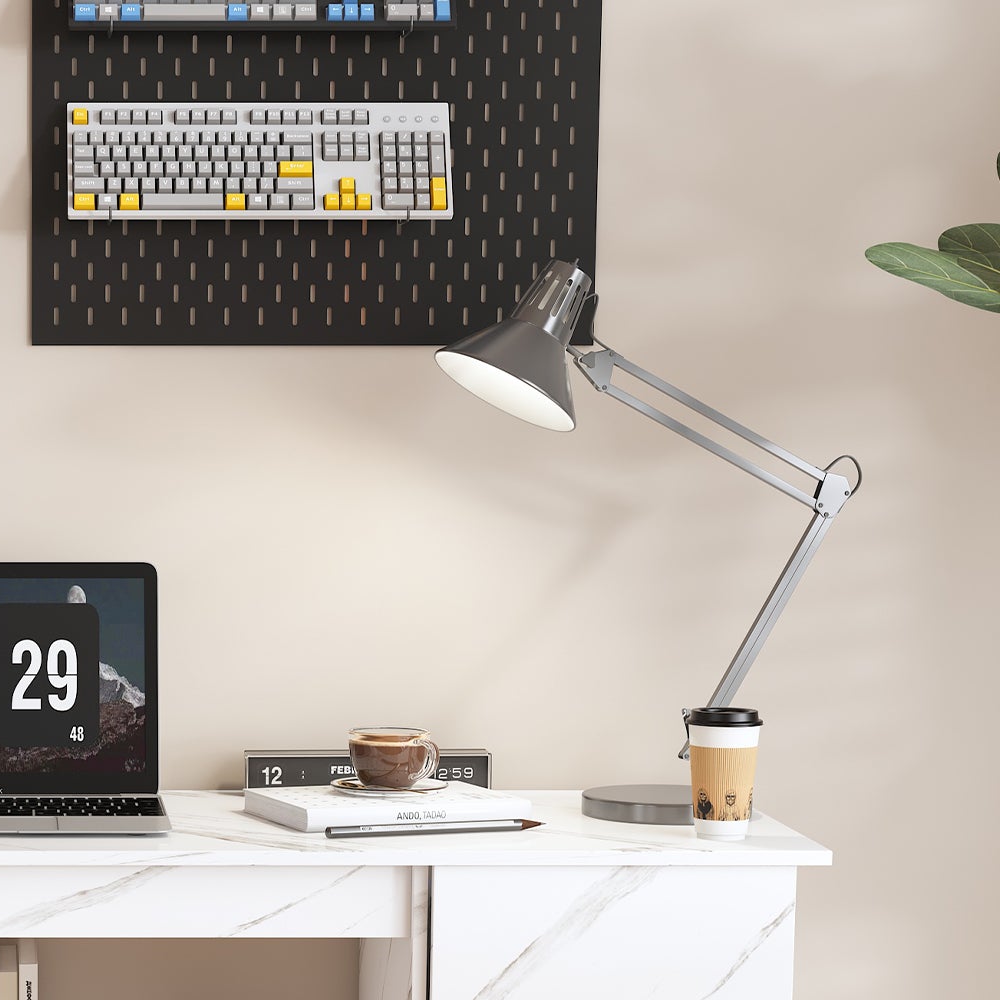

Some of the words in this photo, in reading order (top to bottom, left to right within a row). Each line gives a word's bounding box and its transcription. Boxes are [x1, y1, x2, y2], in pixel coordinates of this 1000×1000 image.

[11, 638, 79, 712] 29
[69, 726, 85, 742] 48
[261, 766, 282, 785] 12
[423, 810, 446, 819] TADAO
